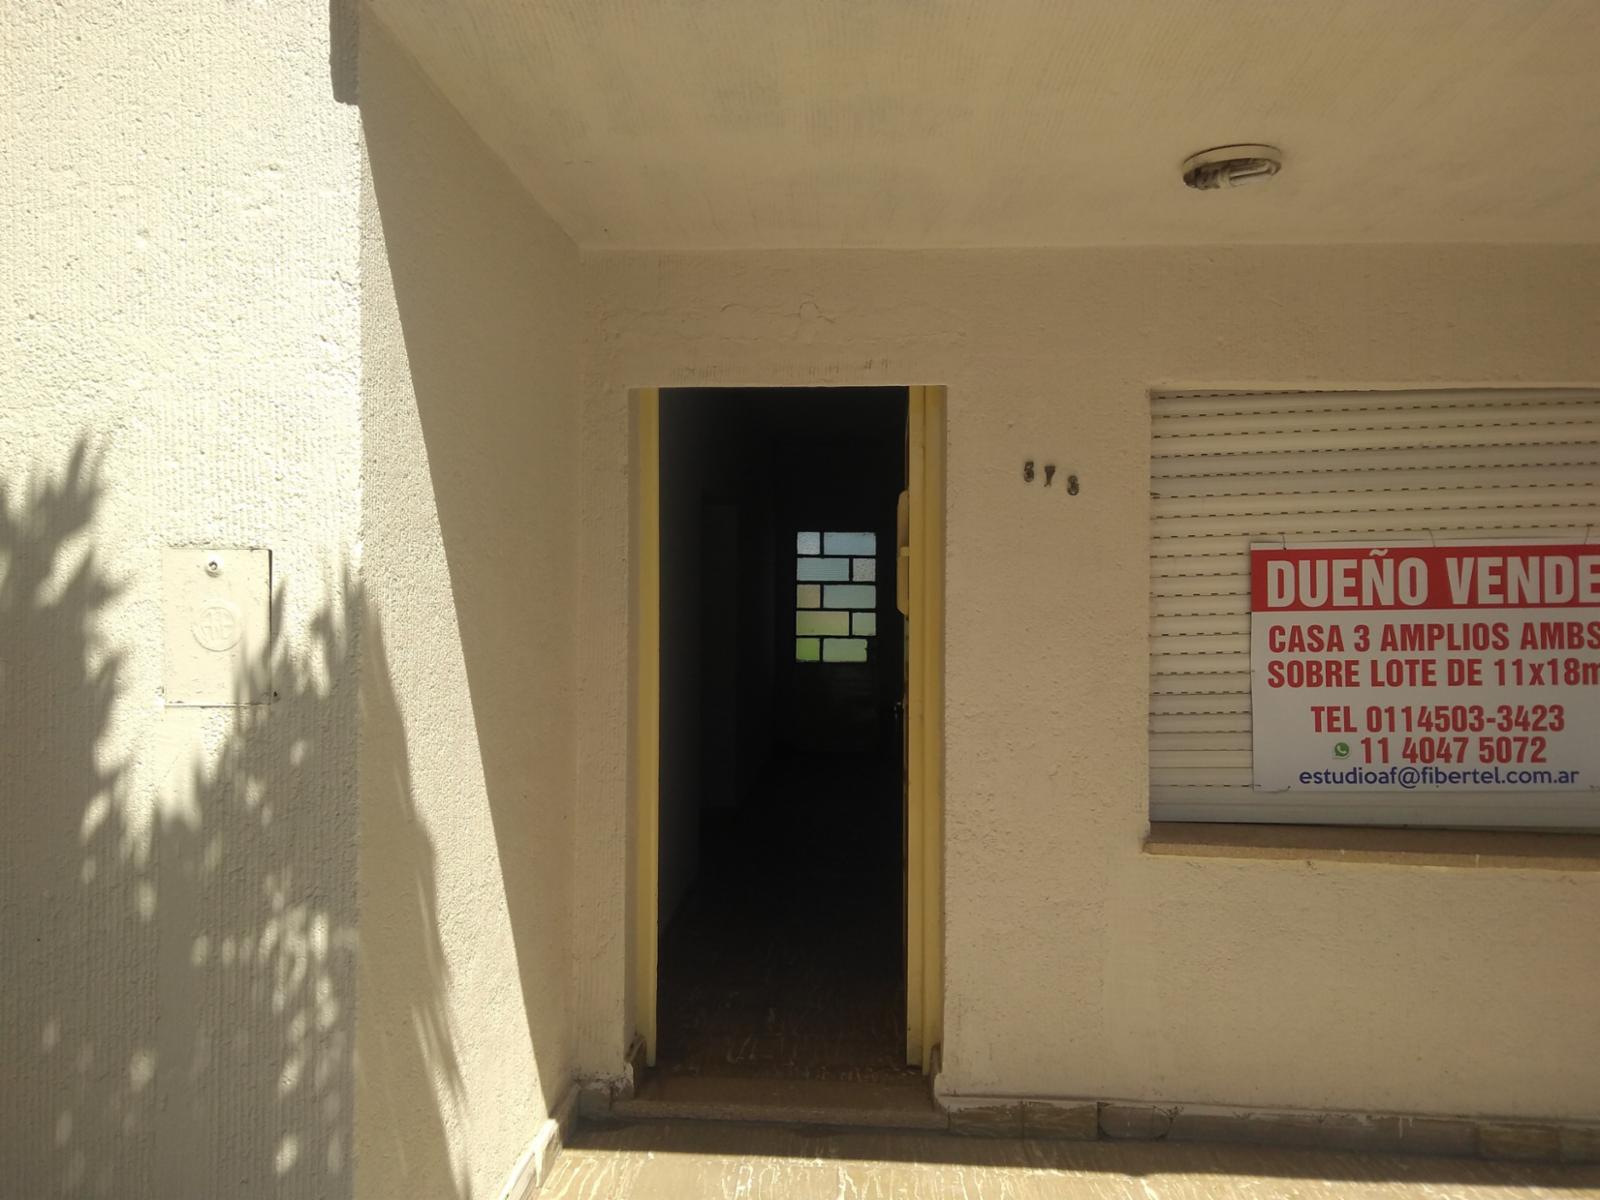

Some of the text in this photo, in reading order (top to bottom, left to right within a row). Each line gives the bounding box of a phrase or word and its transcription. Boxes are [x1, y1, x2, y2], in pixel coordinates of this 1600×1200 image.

[1266, 548, 1600, 607] DUEÑO VENDE
[1268, 621, 1600, 653] CASA 3 AMPLIOS AMBS
[1267, 657, 1600, 688] SOBRE LOTE DE 11x18m
[1310, 704, 1565, 733] TEL 0114503-3423
[1360, 736, 1548, 764] 11 4047 5072
[1299, 766, 1580, 789] estudioaf@fibertel.com.ar
